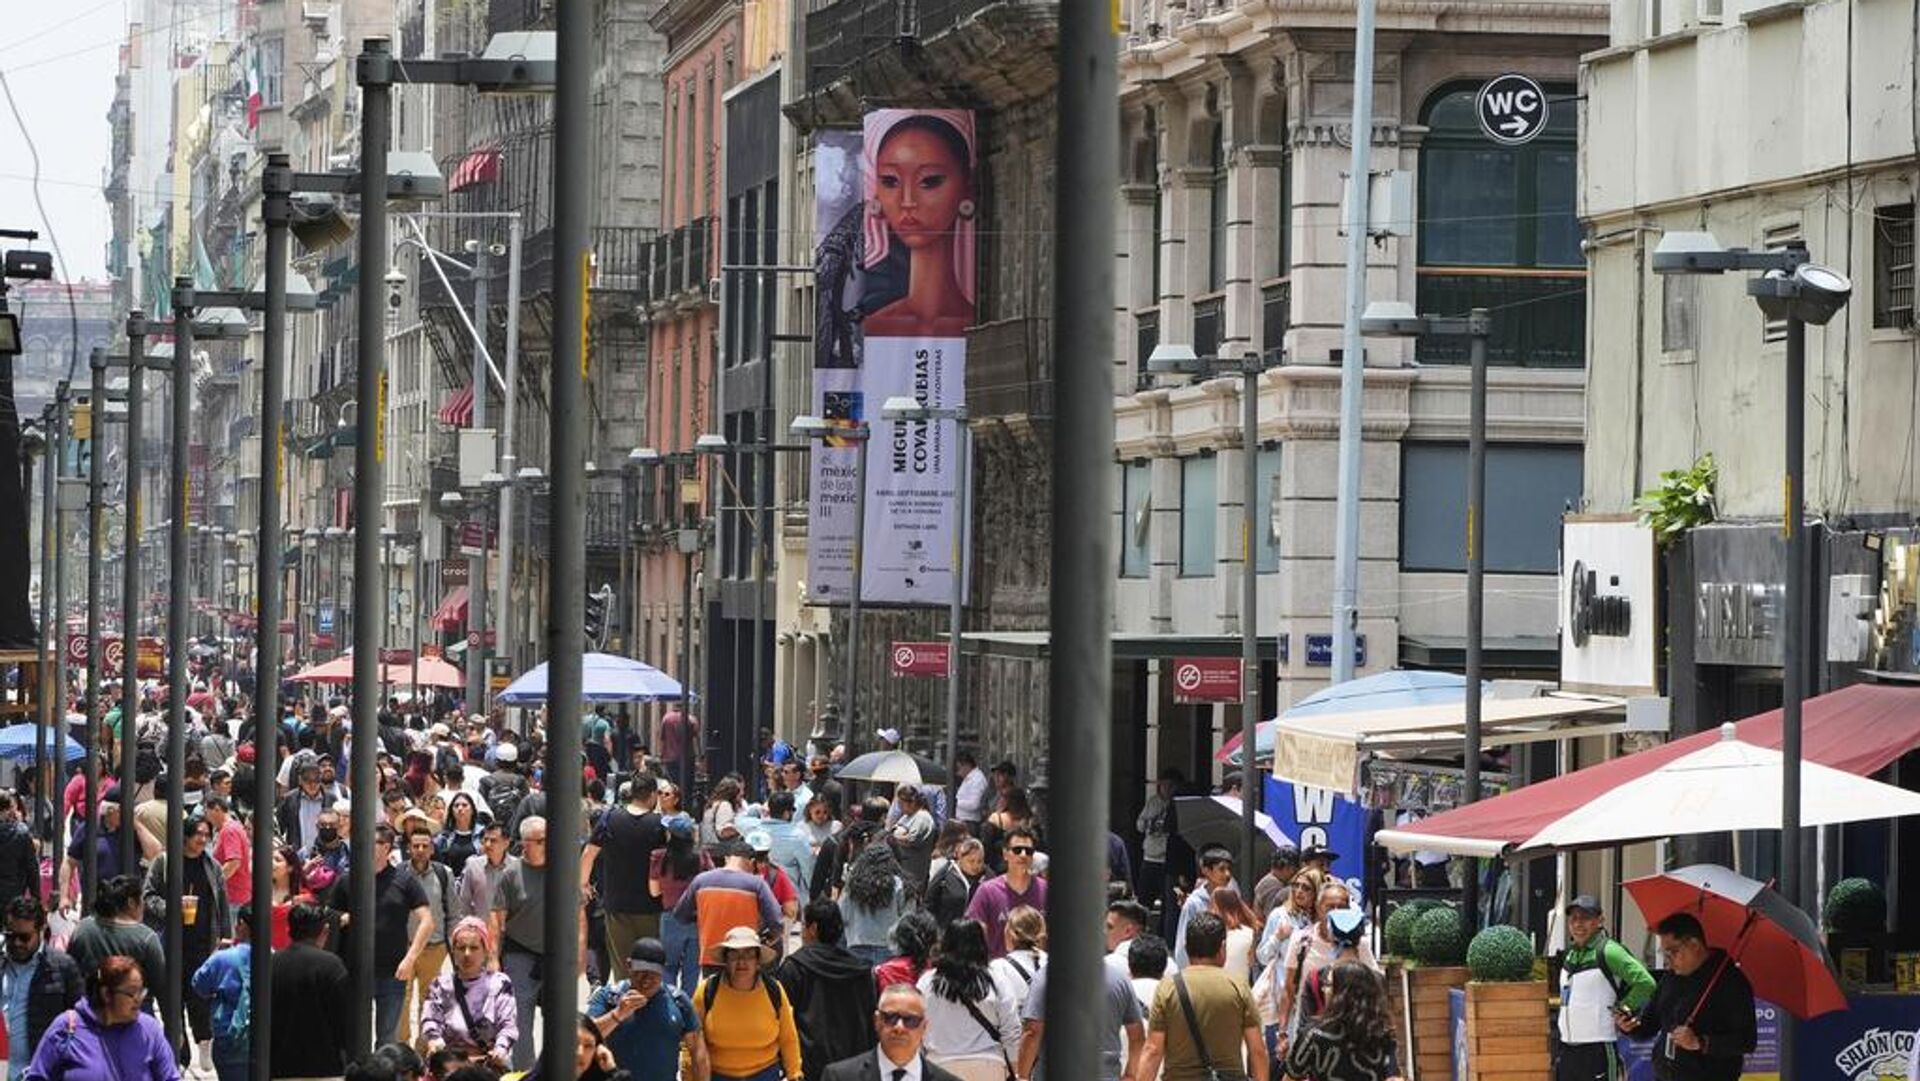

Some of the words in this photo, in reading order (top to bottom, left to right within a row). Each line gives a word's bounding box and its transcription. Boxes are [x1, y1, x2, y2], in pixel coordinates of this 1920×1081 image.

[1486, 89, 1538, 116] WC
[914, 349, 929, 473] COVAUBIAS
[443, 567, 468, 577] croc
[1755, 1007, 1775, 1021] PO
[1839, 1031, 1889, 1072] SALÓN
[1894, 1033, 1916, 1053] CO
